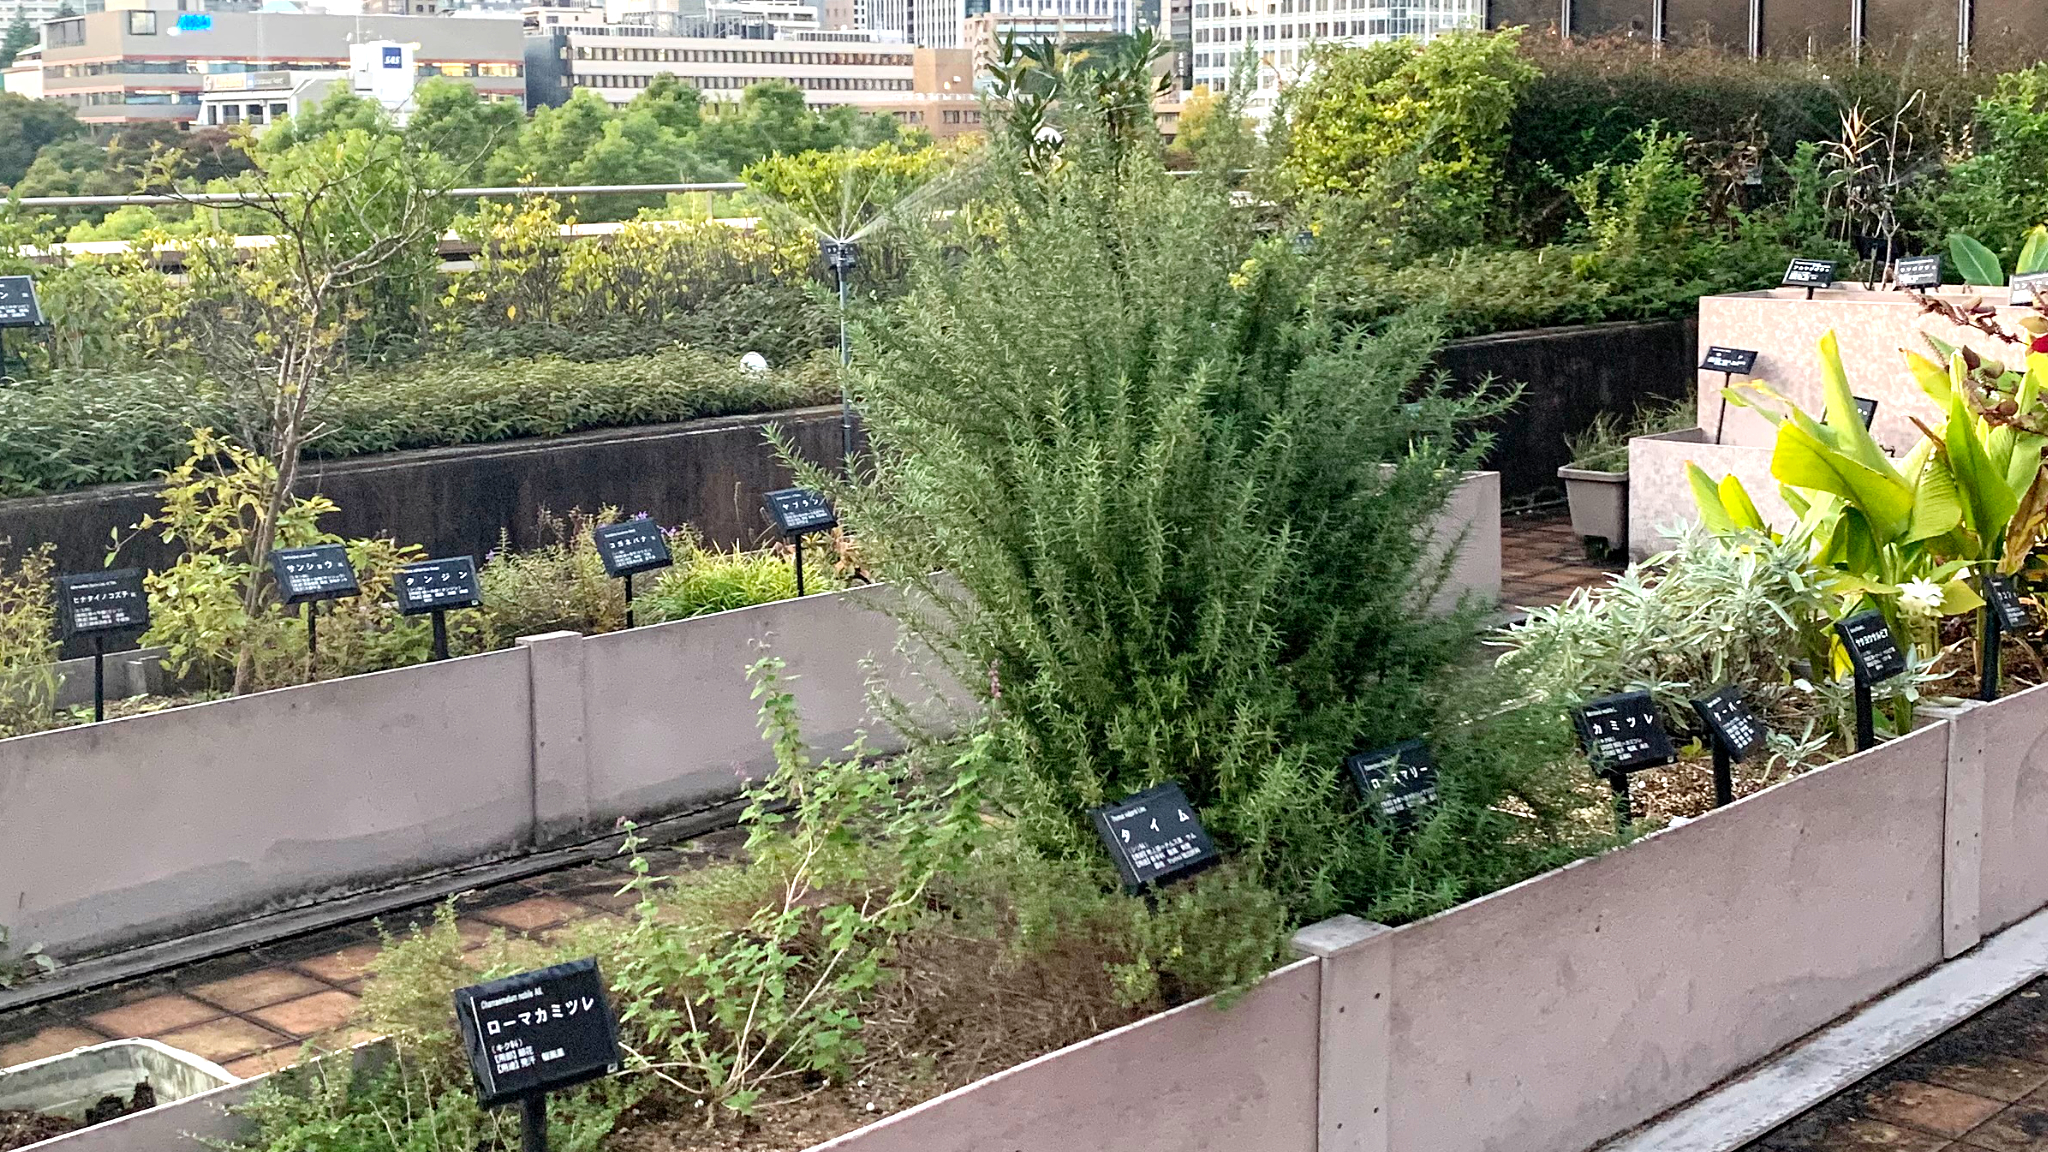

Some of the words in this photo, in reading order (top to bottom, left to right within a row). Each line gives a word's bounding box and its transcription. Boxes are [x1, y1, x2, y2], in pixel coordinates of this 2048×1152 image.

[384, 55, 401, 65] SAS
[1592, 713, 1654, 735] カミツレ
[1121, 808, 1190, 843] タイム
[487, 996, 595, 1035] ローマカミツレ
